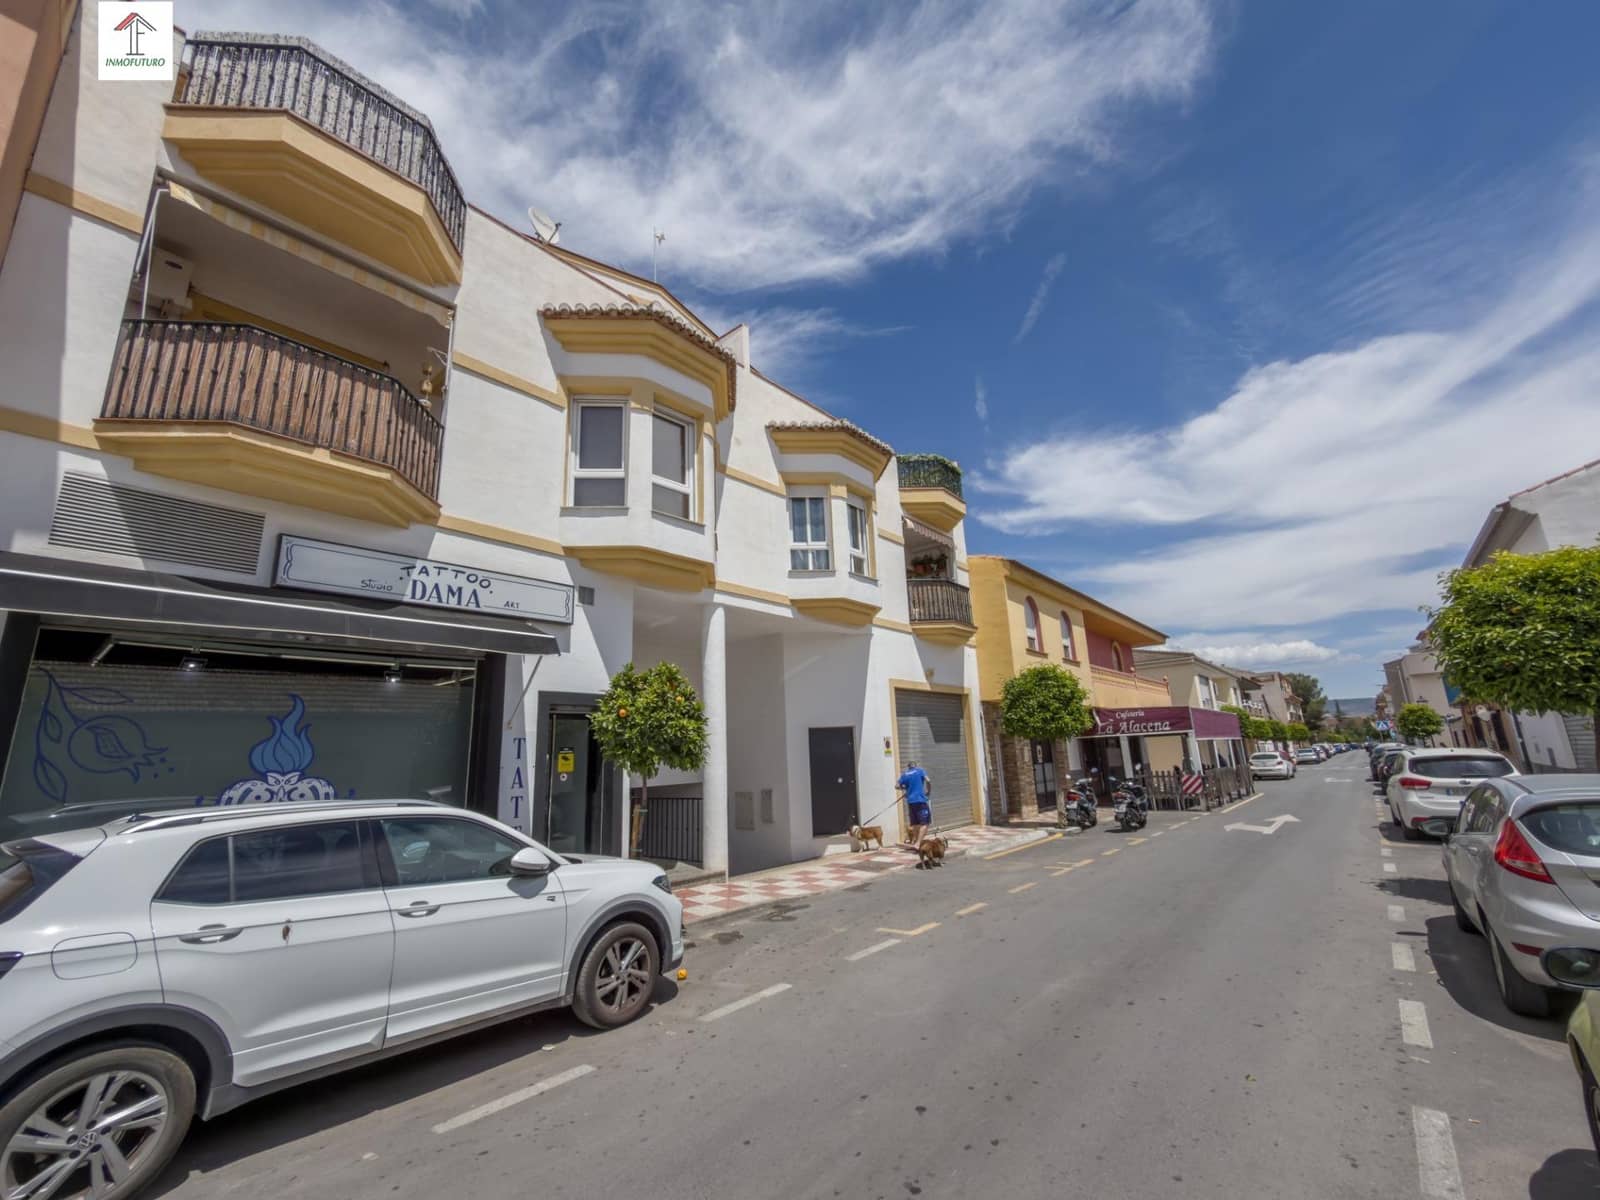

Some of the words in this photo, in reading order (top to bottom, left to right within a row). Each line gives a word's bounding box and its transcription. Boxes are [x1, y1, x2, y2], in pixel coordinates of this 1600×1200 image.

[410, 580, 481, 608] DAMA
[1119, 720, 1171, 734] Alacena
[510, 737, 527, 831] TAT
